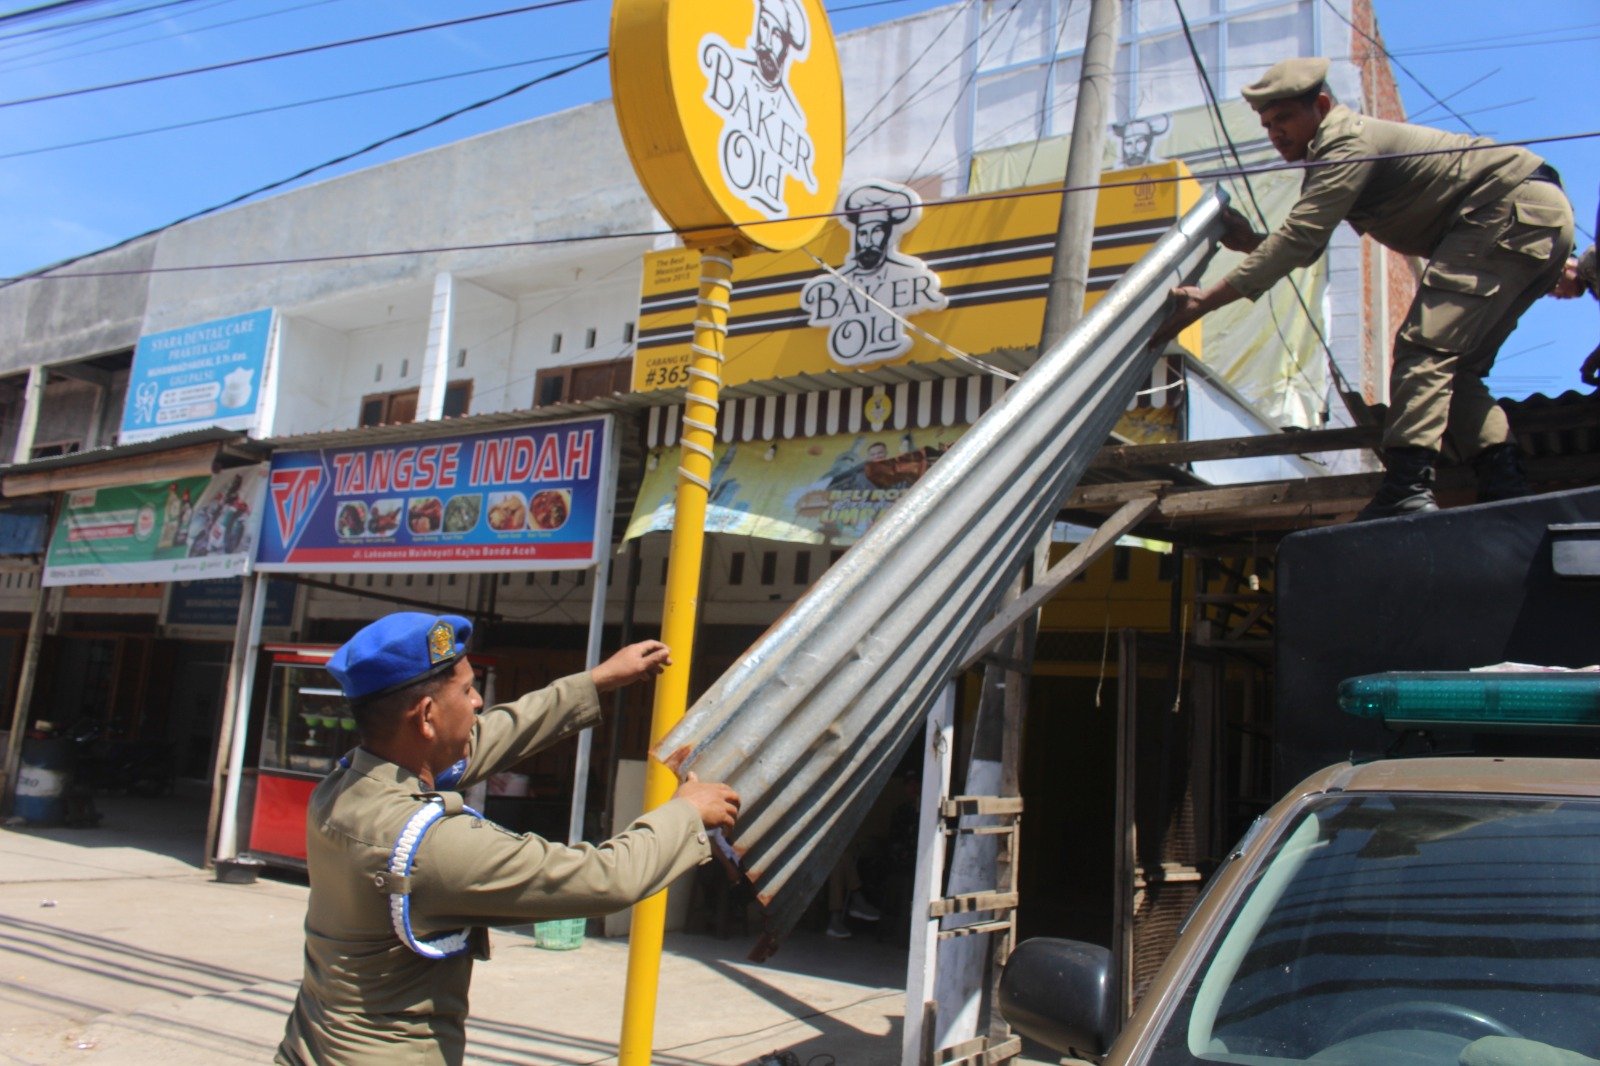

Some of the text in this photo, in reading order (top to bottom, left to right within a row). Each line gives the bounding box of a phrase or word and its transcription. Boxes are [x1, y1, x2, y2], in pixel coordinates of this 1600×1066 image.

[702, 42, 815, 186] BAKER
[723, 129, 783, 203] Old
[805, 275, 939, 321] BAKER
[225, 319, 255, 336] CARE
[832, 316, 897, 359] Old
[645, 365, 690, 386] #365
[646, 356, 678, 367] CABANG
[332, 429, 595, 496] TANGSE INDAH
[482, 547, 511, 557] Banda
[512, 546, 536, 556] Aceh
